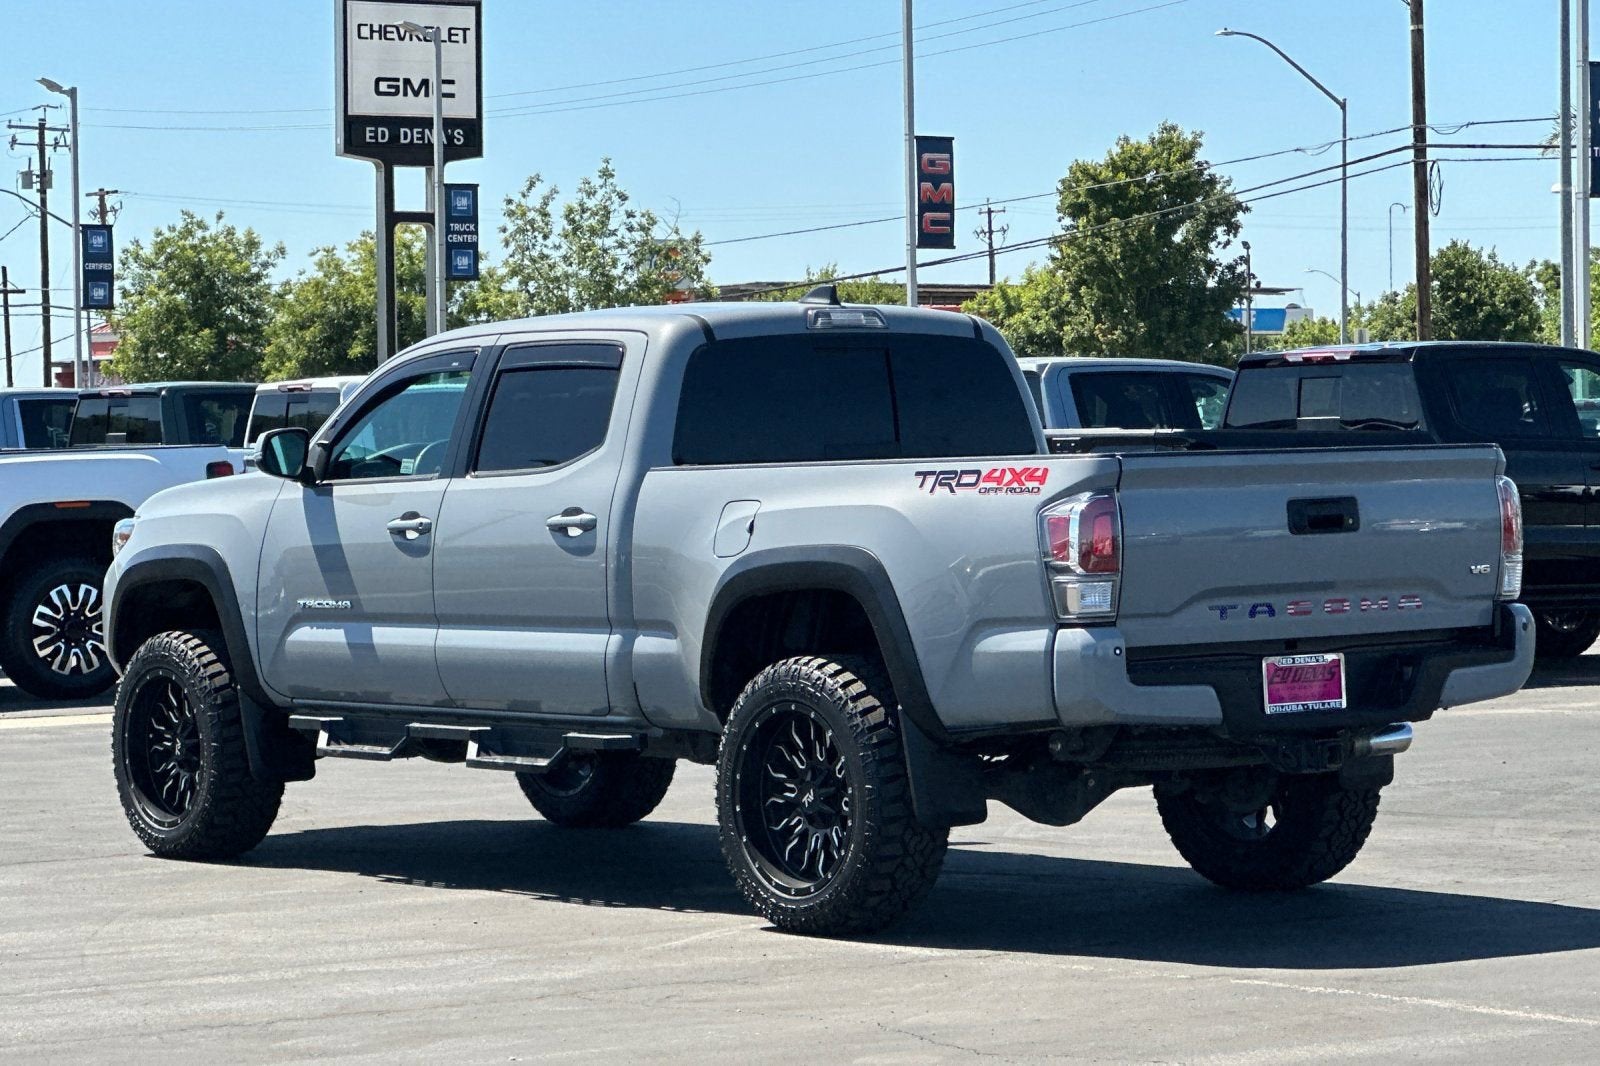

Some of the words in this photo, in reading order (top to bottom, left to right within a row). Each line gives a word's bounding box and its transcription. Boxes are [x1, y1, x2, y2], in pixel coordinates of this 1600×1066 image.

[374, 77, 456, 98] GMC
[365, 127, 389, 143] ED
[920, 153, 953, 233] GMC
[450, 223, 475, 232] TRUCK
[447, 234, 477, 243] CENTER
[84, 262, 112, 270] CERTIFIED
[914, 469, 982, 494] TRD
[978, 486, 1004, 495] OFF
[1005, 486, 1041, 495] ROAD
[1470, 564, 1490, 574] V6
[296, 598, 351, 609] TACOMA
[1207, 594, 1423, 620] TACOMA
[1307, 701, 1342, 710] TULARE
